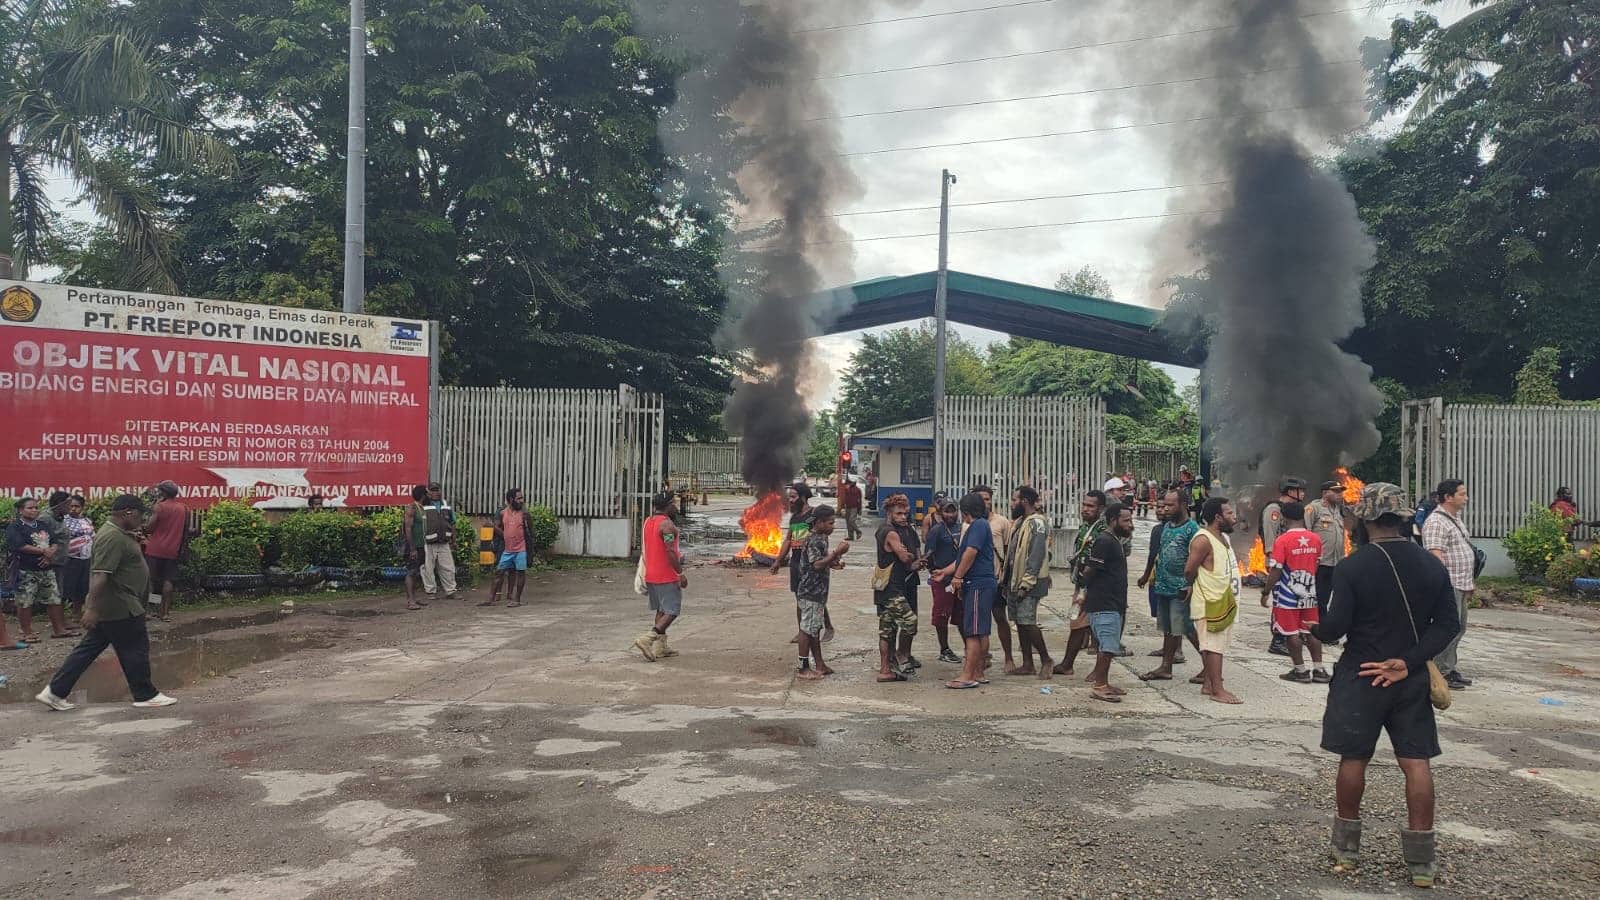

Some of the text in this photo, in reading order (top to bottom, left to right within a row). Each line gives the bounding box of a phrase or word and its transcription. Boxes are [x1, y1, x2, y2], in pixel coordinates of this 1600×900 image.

[67, 289, 375, 329] Pertambangan Tembaga, Emas dan Perak
[84, 312, 362, 348] PT. FREEPORT INDONESIA
[13, 340, 406, 386] OBJEK VITAL NASIONAL
[0, 372, 420, 407] BIDANG ENERGI DAN SUMBER DAYA MINERAL
[126, 419, 329, 436] DITETAPKAN BERDASARKAN
[42, 433, 390, 450] KEPUTUSAN PRESIDEN RI NOMOR 63 TAHUN 2004
[19, 448, 404, 463] KEPUTUSAN MENTERI ESDM NOMOR 77/K/90/MEM/2019
[234, 485, 349, 498] MEMANFAATKAN
[353, 485, 393, 496] TANPA
[397, 484, 416, 496] IZI
